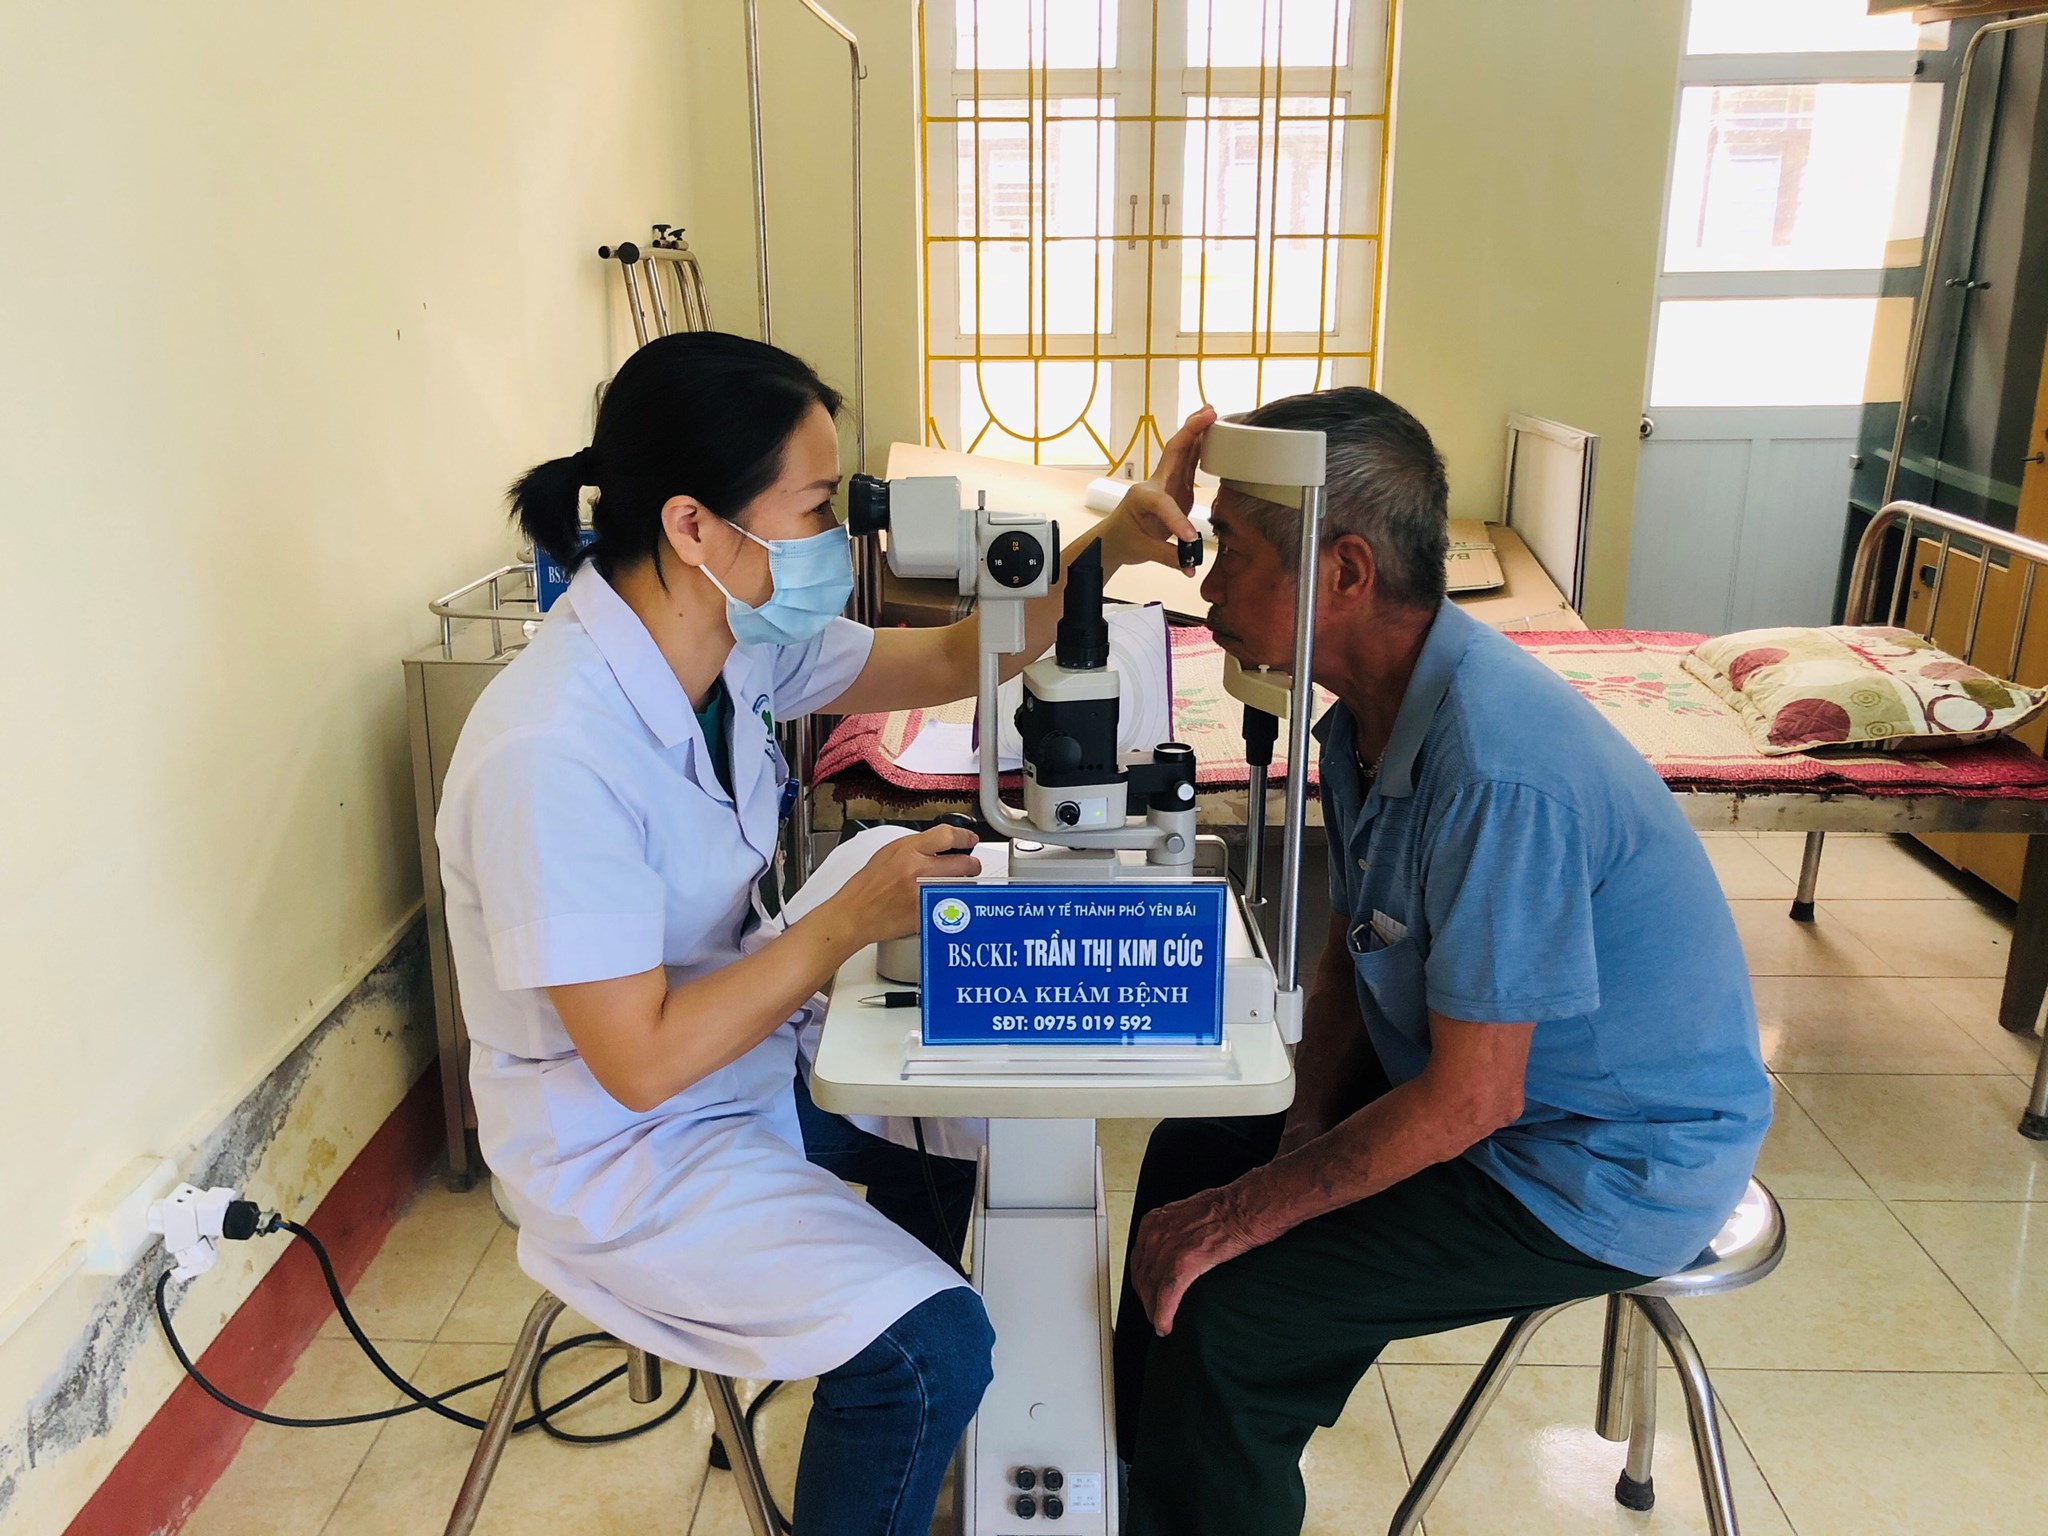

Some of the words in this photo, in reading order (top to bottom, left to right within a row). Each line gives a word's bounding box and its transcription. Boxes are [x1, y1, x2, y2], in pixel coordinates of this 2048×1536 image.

[975, 906, 1015, 916] TRUNG
[1018, 903, 1044, 916] TÂM
[1048, 906, 1056, 916] Y
[1059, 902, 1072, 916] TẾ
[1074, 902, 1116, 916] THÀNH
[1120, 901, 1146, 916] PHỐ
[1149, 903, 1173, 916] YÊN
[1177, 902, 1196, 916] BÁI
[948, 943, 1019, 967] BS.CKI:
[1024, 929, 1076, 966] TRẦN
[1082, 939, 1113, 972] THỊ
[1119, 940, 1157, 966] KIM
[1164, 934, 1204, 966] CÚC
[957, 987, 1029, 1003] KHOA
[1036, 982, 1110, 1002] KHÁM
[1118, 982, 1188, 1007] BỆNH
[993, 1016, 1028, 1030] SĐT:
[1034, 1016, 1077, 1030] 0975
[1083, 1016, 1115, 1030] 019
[1120, 1016, 1152, 1030] 592
